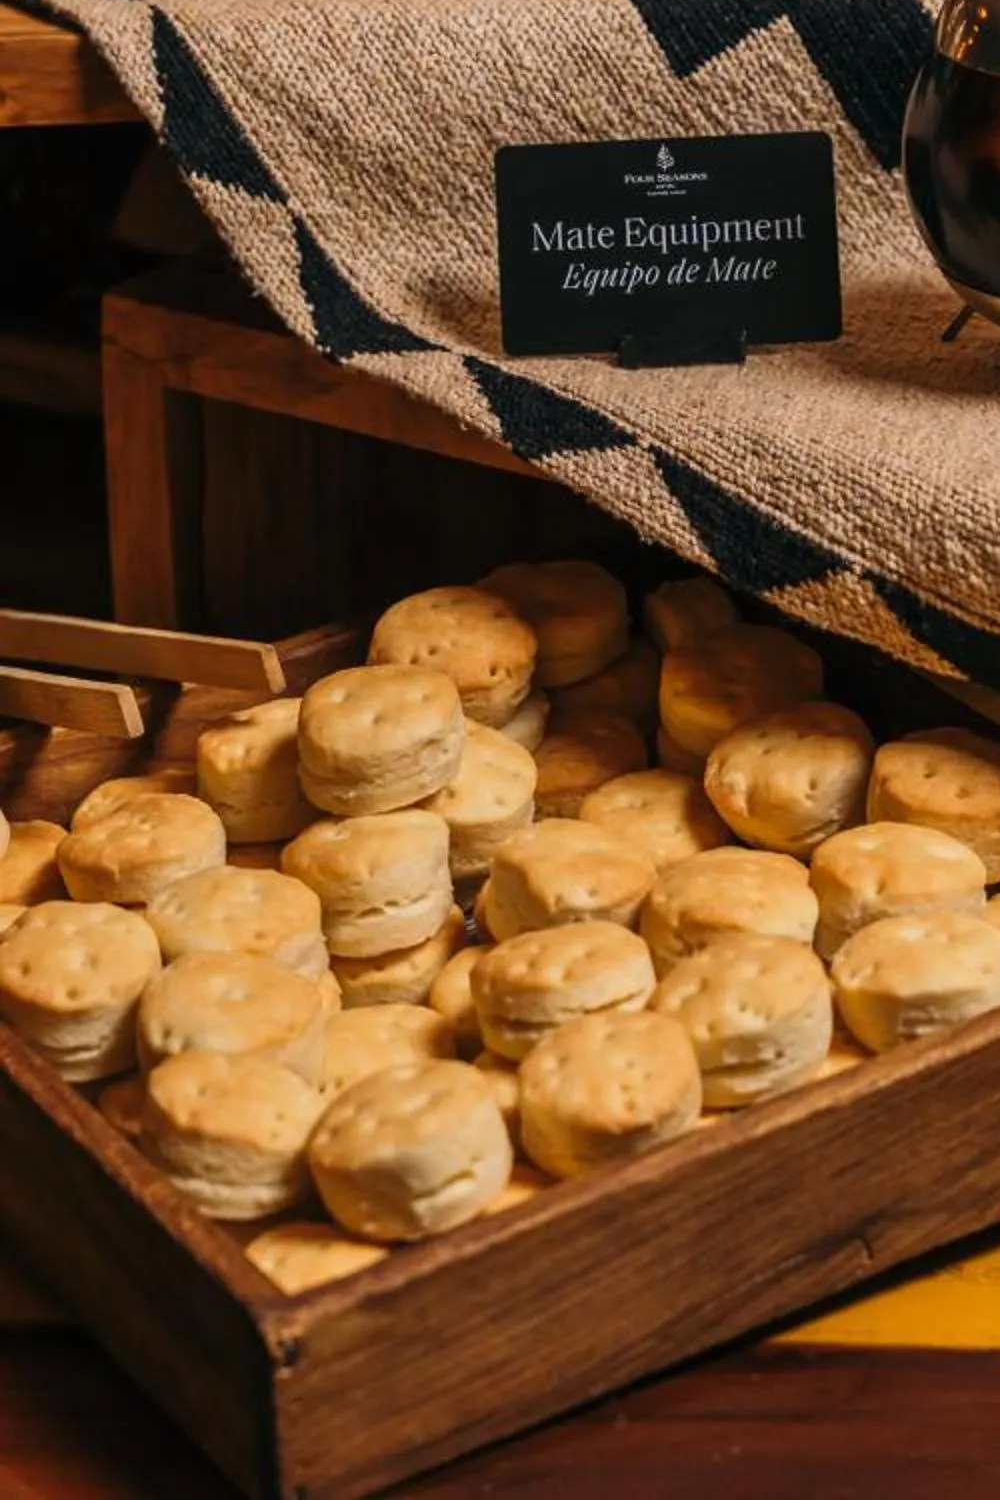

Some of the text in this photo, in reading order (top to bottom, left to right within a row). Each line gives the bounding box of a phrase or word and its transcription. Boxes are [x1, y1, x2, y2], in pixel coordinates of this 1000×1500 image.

[531, 213, 806, 254] Mate Equipment
[562, 256, 777, 296] Equipo de Mate
